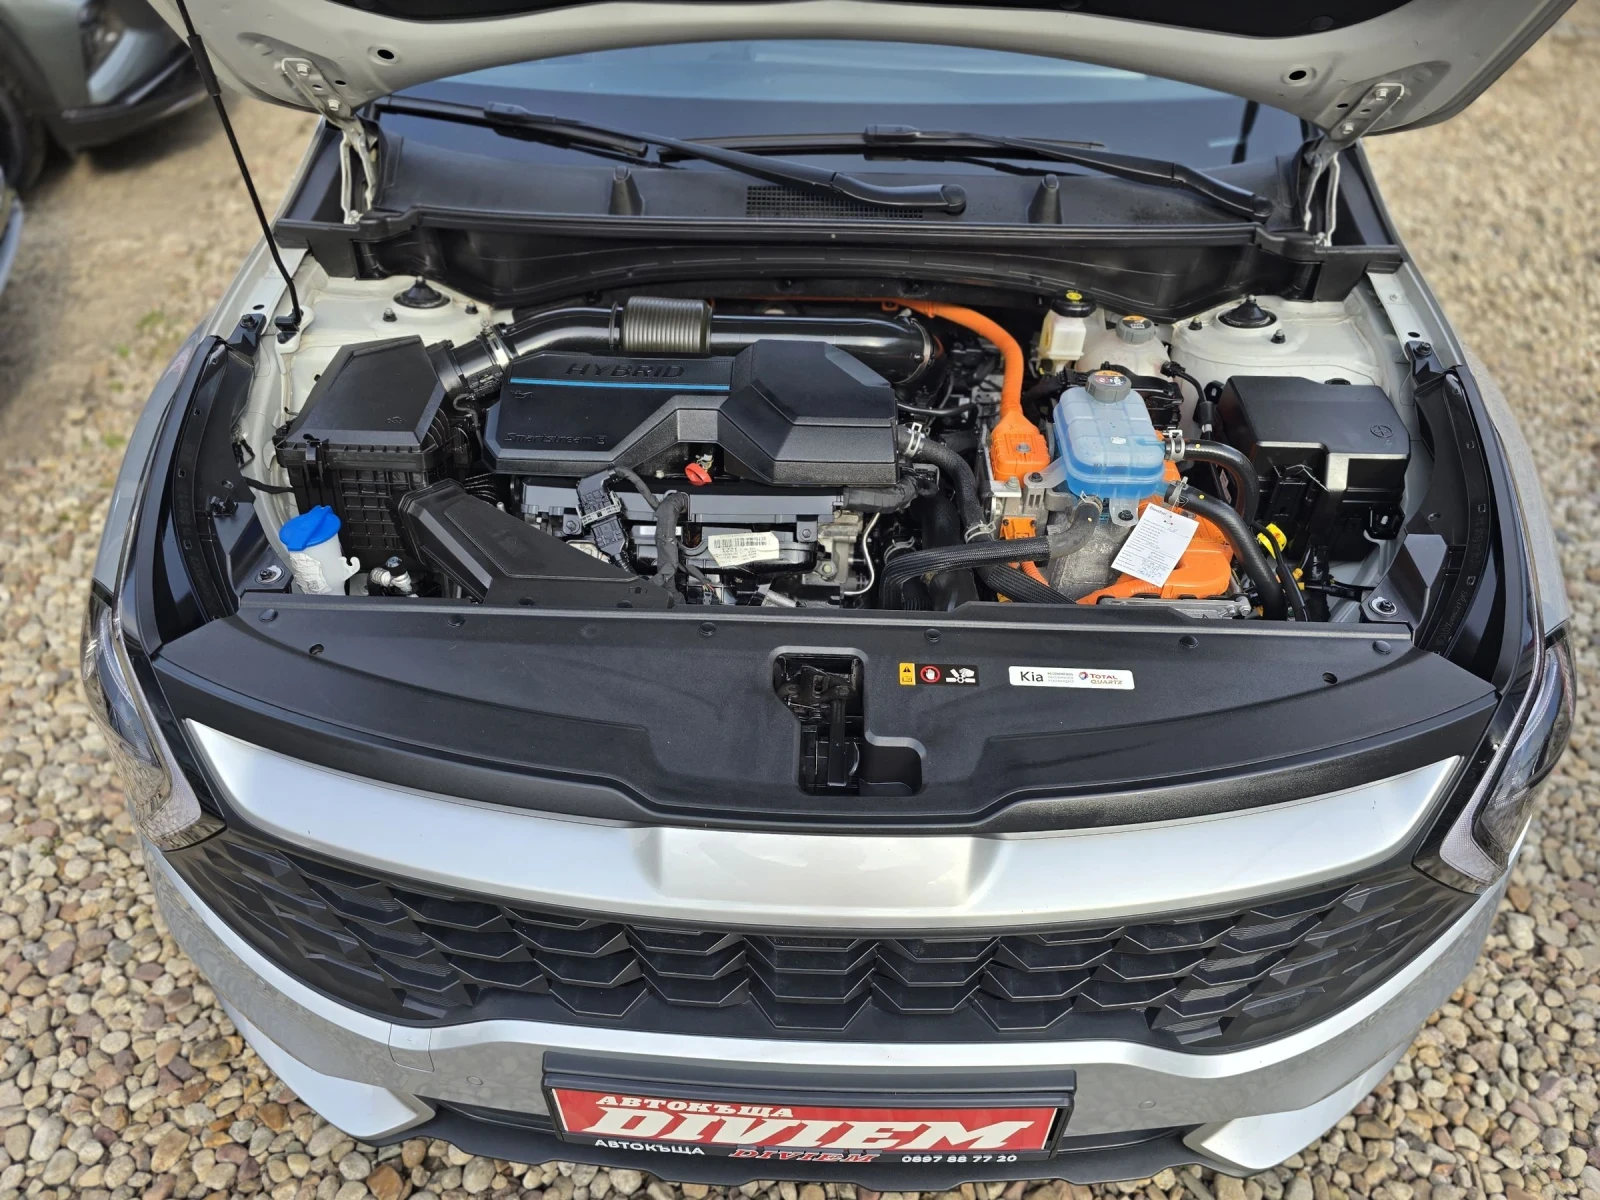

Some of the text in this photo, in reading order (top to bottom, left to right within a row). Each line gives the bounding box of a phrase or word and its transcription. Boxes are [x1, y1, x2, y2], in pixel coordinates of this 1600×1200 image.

[565, 363, 685, 378] HYBRID
[504, 432, 593, 444] Smartstream
[1020, 671, 1044, 682] Kia
[595, 1095, 794, 1118] АВТОКЪЩА
[581, 1106, 1035, 1149] DIVIEM
[594, 1139, 705, 1155] АВТОКЪЩА
[728, 1148, 880, 1163] DIVIEM
[901, 1155, 941, 1163] 0897
[972, 1155, 993, 1163] 77
[996, 1154, 1018, 1163] 20
